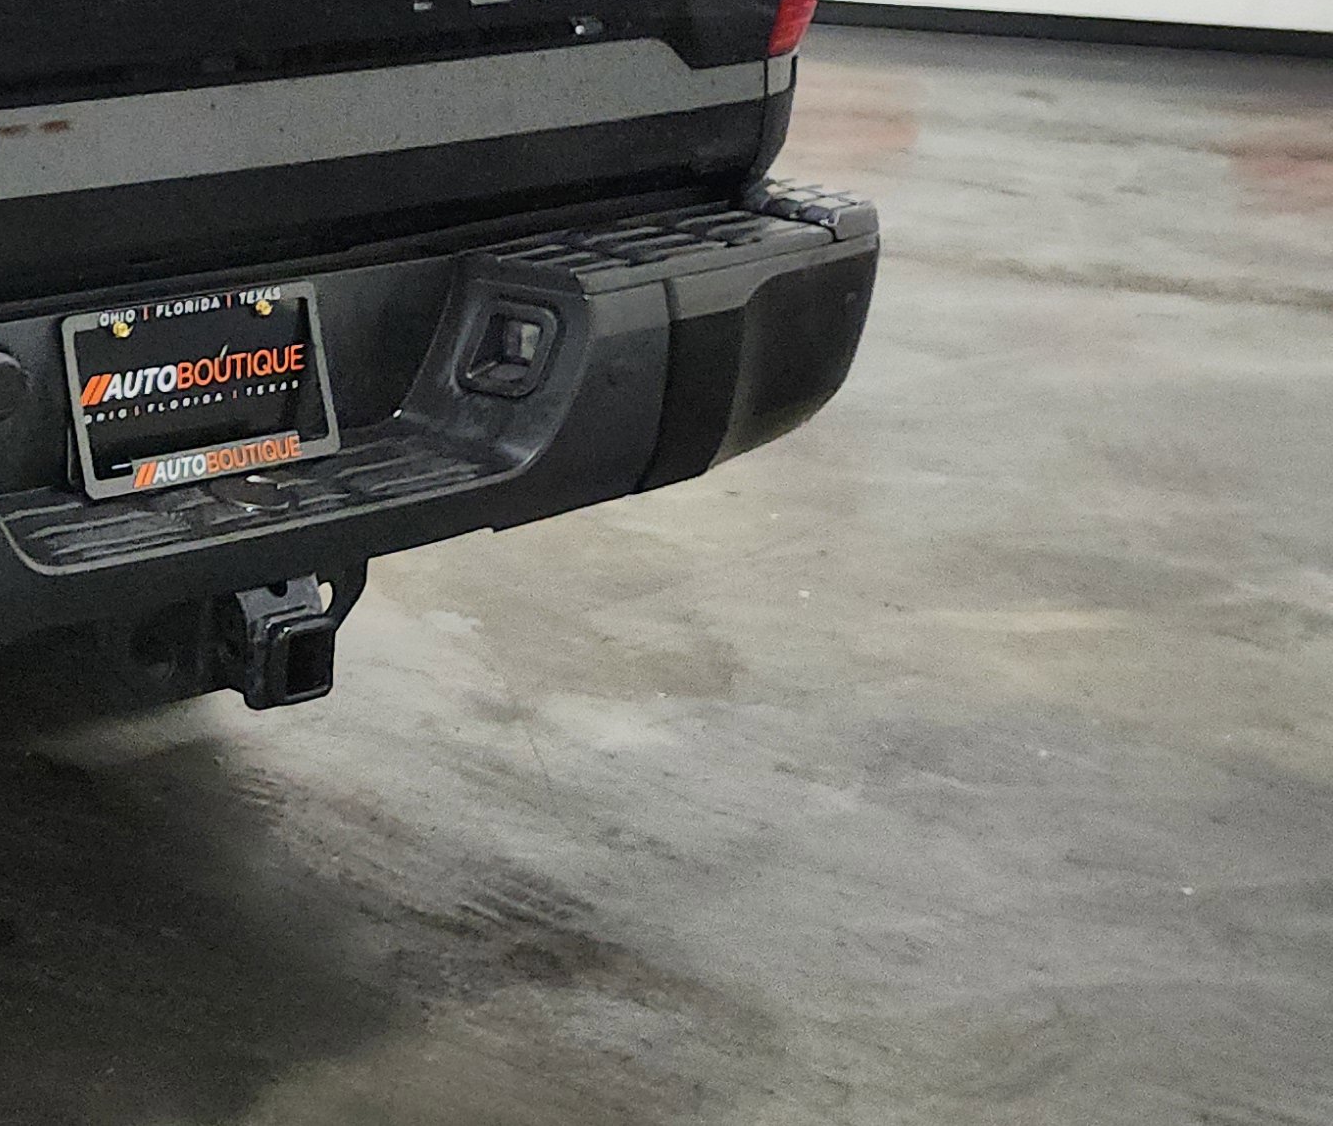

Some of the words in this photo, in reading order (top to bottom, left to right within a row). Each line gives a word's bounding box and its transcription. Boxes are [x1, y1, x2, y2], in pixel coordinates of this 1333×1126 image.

[99, 309, 136, 327] OHIO
[155, 296, 221, 318] FLORIDA
[238, 286, 282, 305] TEXAS
[151, 435, 300, 485] AUTOBOUTIQUE
